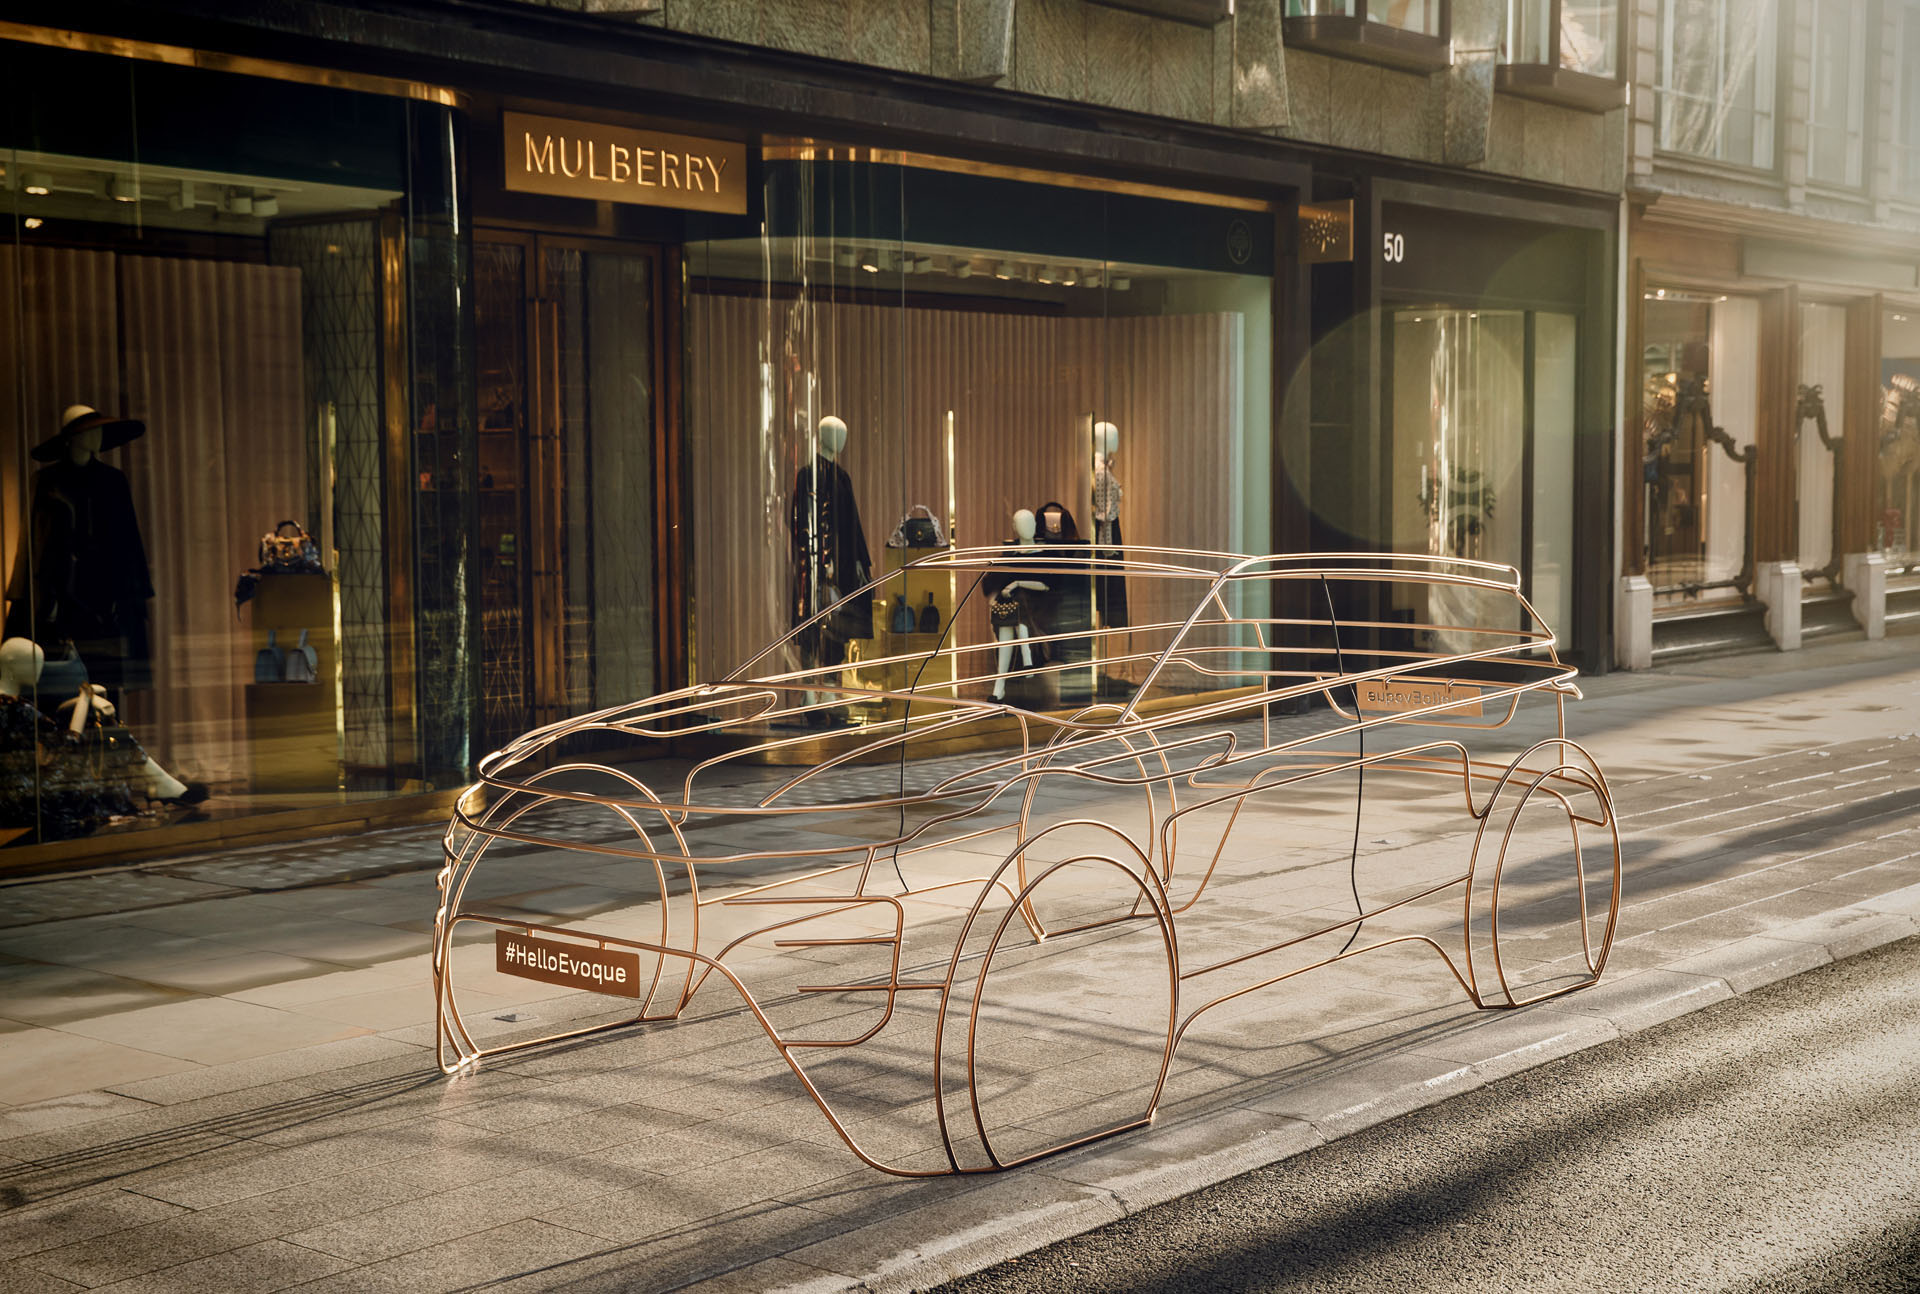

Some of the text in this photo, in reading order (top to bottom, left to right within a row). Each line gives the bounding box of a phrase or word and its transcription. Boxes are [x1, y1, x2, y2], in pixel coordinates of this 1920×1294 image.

[525, 132, 727, 193] MULBERRY
[1383, 232, 1404, 263] 50
[505, 941, 627, 984] #HelloEvoque
